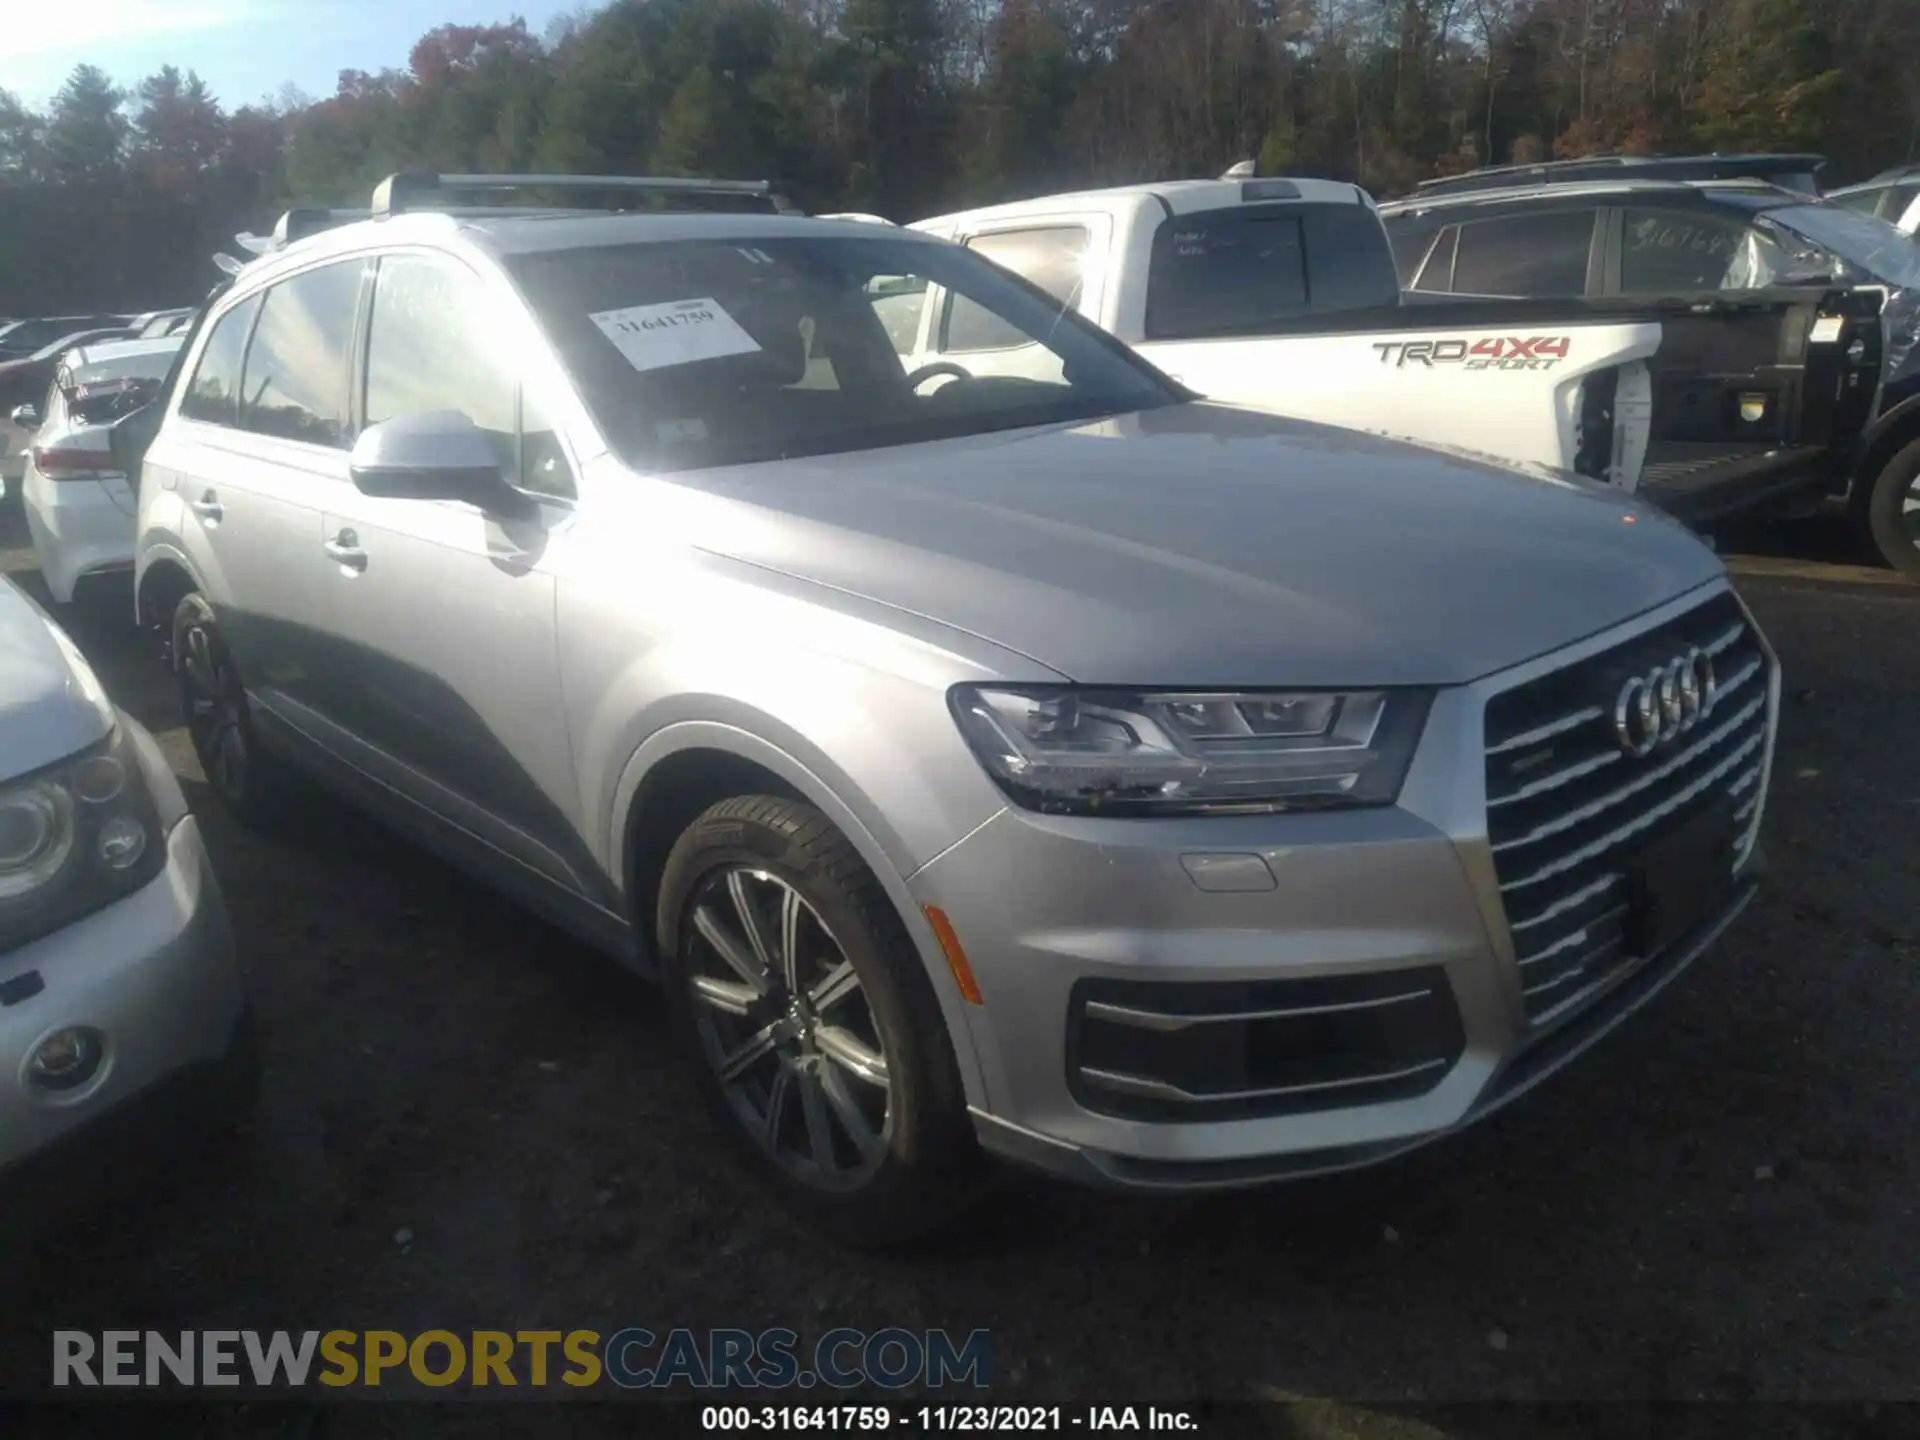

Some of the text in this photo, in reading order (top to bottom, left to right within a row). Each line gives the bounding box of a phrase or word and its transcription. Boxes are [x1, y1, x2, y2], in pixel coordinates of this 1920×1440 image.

[615, 310, 715, 333] 31641759
[1373, 340, 1468, 368] TRD
[1463, 358, 1563, 370] SPORT
